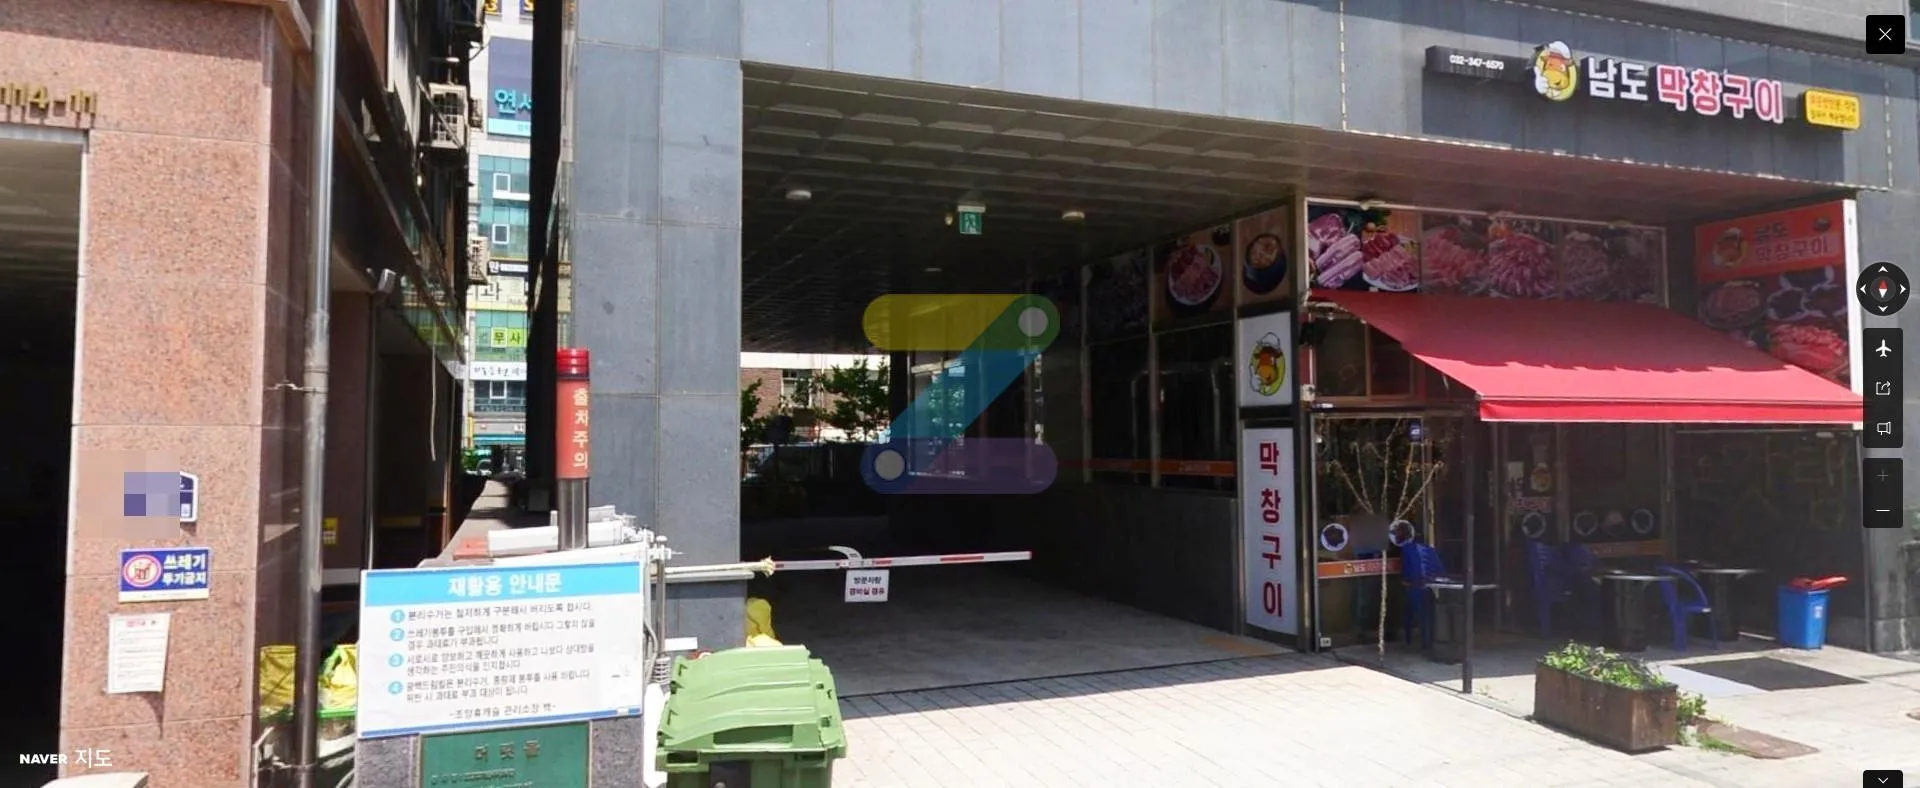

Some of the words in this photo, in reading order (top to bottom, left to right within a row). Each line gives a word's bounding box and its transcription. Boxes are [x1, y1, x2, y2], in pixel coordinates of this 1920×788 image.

[1587, 56, 1649, 101] 남도
[1656, 64, 1784, 124] 막창구이
[572, 387, 589, 469] 출차주의
[1259, 442, 1282, 617] 막창구이
[162, 571, 207, 585] 투기금지
[163, 553, 206, 570] 쓰레기
[448, 575, 502, 597] 재활용
[509, 572, 562, 594] 안내문
